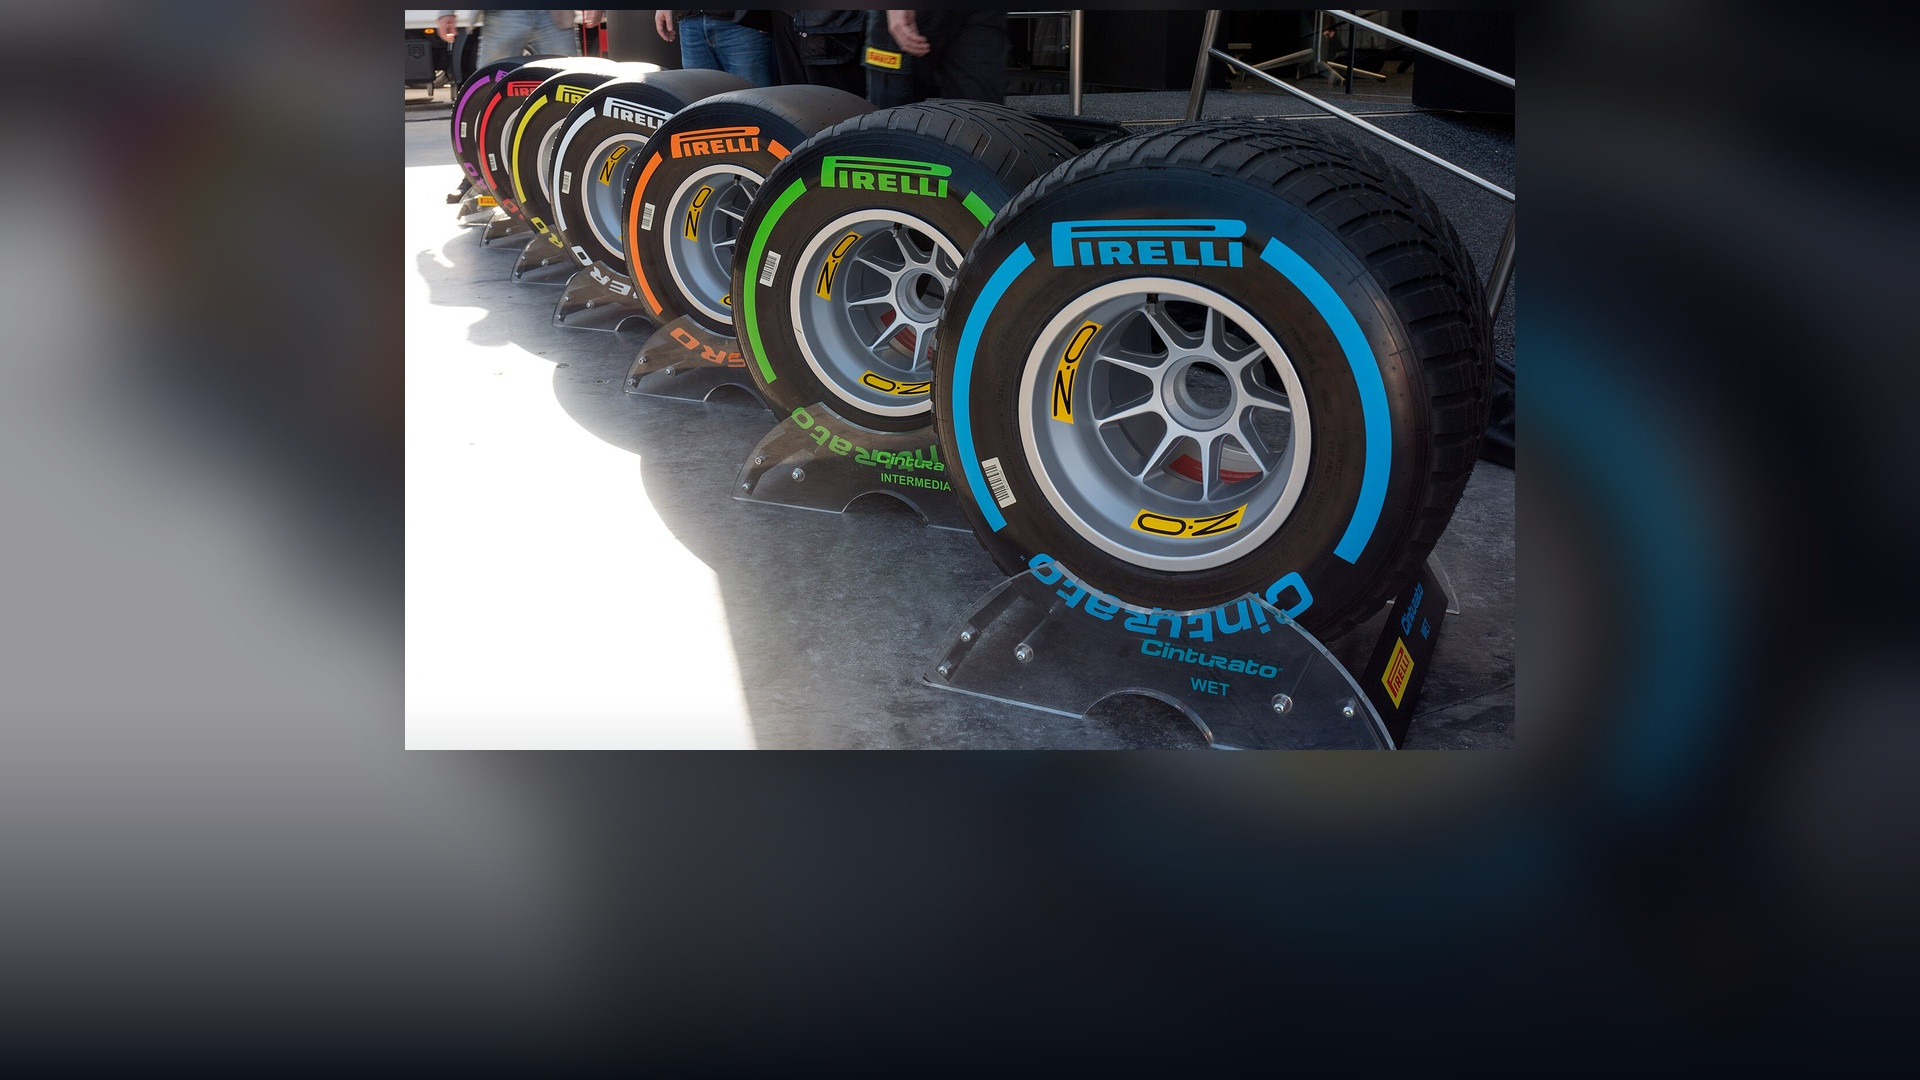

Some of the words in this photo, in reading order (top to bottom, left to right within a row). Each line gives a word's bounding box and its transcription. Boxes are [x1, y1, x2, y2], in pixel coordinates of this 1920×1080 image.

[671, 126, 761, 159] PIRELLI
[821, 155, 953, 198] PIRELLI
[1051, 219, 1247, 268] PIRELLI
[876, 451, 945, 472] Cintura
[880, 472, 952, 492] INTERMEDIA
[1140, 638, 1279, 680] Cinturato
[1386, 646, 1410, 699] PIRELLI
[1190, 676, 1230, 697] WET
